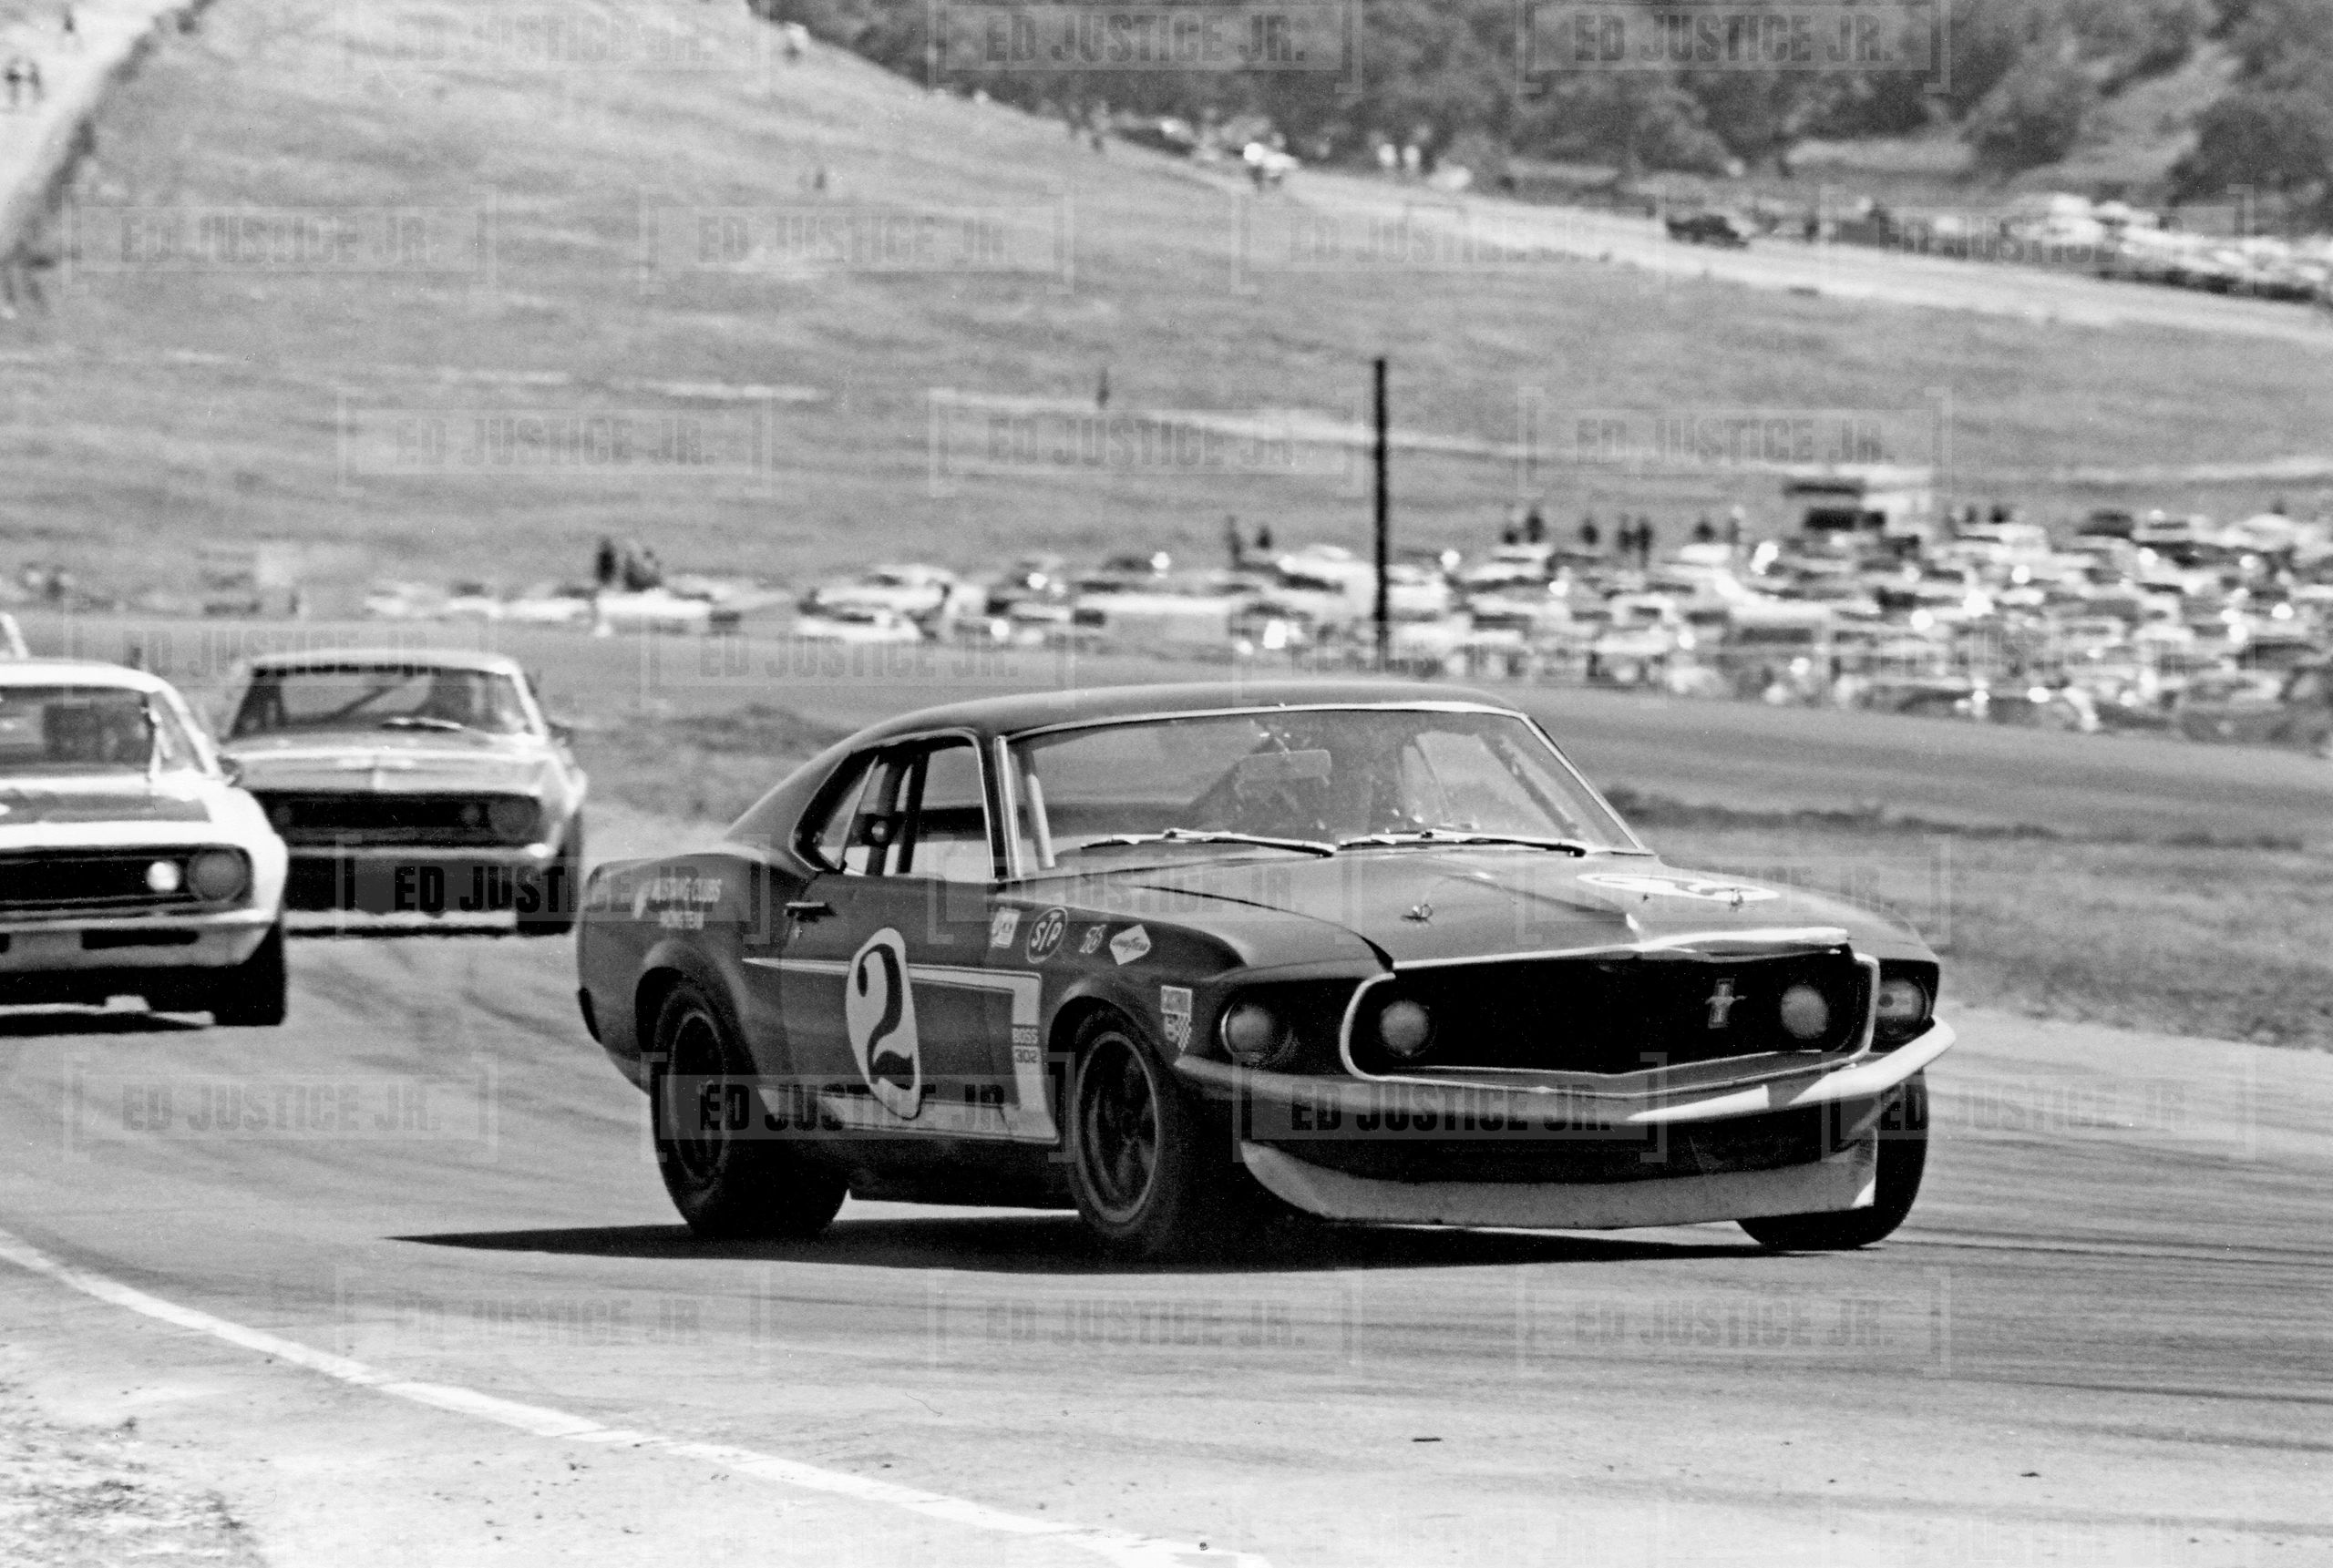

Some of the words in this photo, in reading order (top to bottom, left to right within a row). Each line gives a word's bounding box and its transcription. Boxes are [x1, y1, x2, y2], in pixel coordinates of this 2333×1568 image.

[1030, 912, 1063, 952] STP
[858, 943, 912, 1091] 2
[1012, 1028, 1039, 1044] BOSS
[1014, 1049, 1038, 1063] 302
